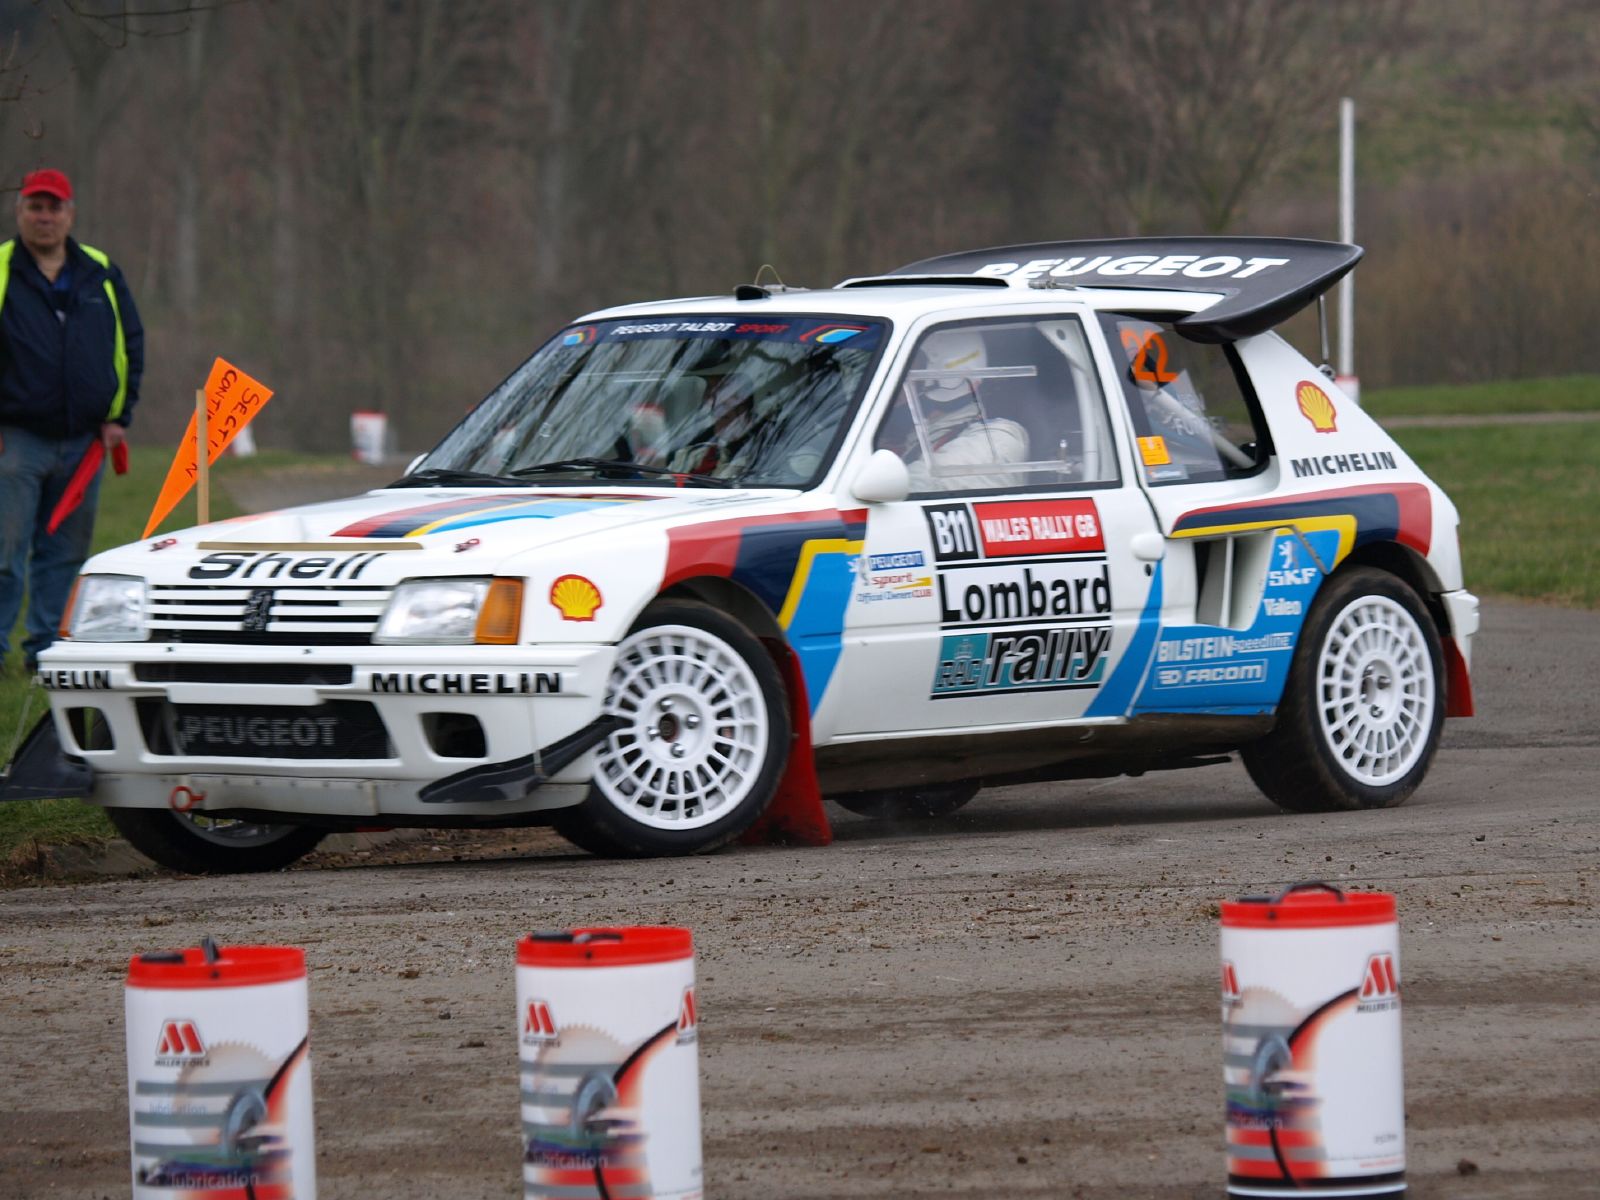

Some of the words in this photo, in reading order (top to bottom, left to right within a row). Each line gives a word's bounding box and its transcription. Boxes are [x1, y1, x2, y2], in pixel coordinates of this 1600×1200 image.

[970, 255, 1290, 279] PEUGEOT
[610, 323, 678, 335] PEUGEOT
[677, 323, 736, 332] TALBOT
[735, 324, 790, 333] SPORT
[1290, 451, 1397, 478] MICHELIN
[929, 510, 975, 554] B11
[980, 517, 1032, 543] WALES
[1030, 515, 1075, 541] RALLY
[1074, 514, 1099, 538] GB
[186, 552, 388, 580] Shell
[1268, 568, 1317, 587] SKF
[872, 573, 913, 589] sport
[937, 564, 1113, 623] Lombard
[1263, 598, 1302, 617] Valeo
[985, 625, 1115, 686] rally
[1156, 635, 1235, 663] BILSTEIN
[370, 672, 561, 694] MICHELIN
[181, 716, 339, 747] PEUGEOT
